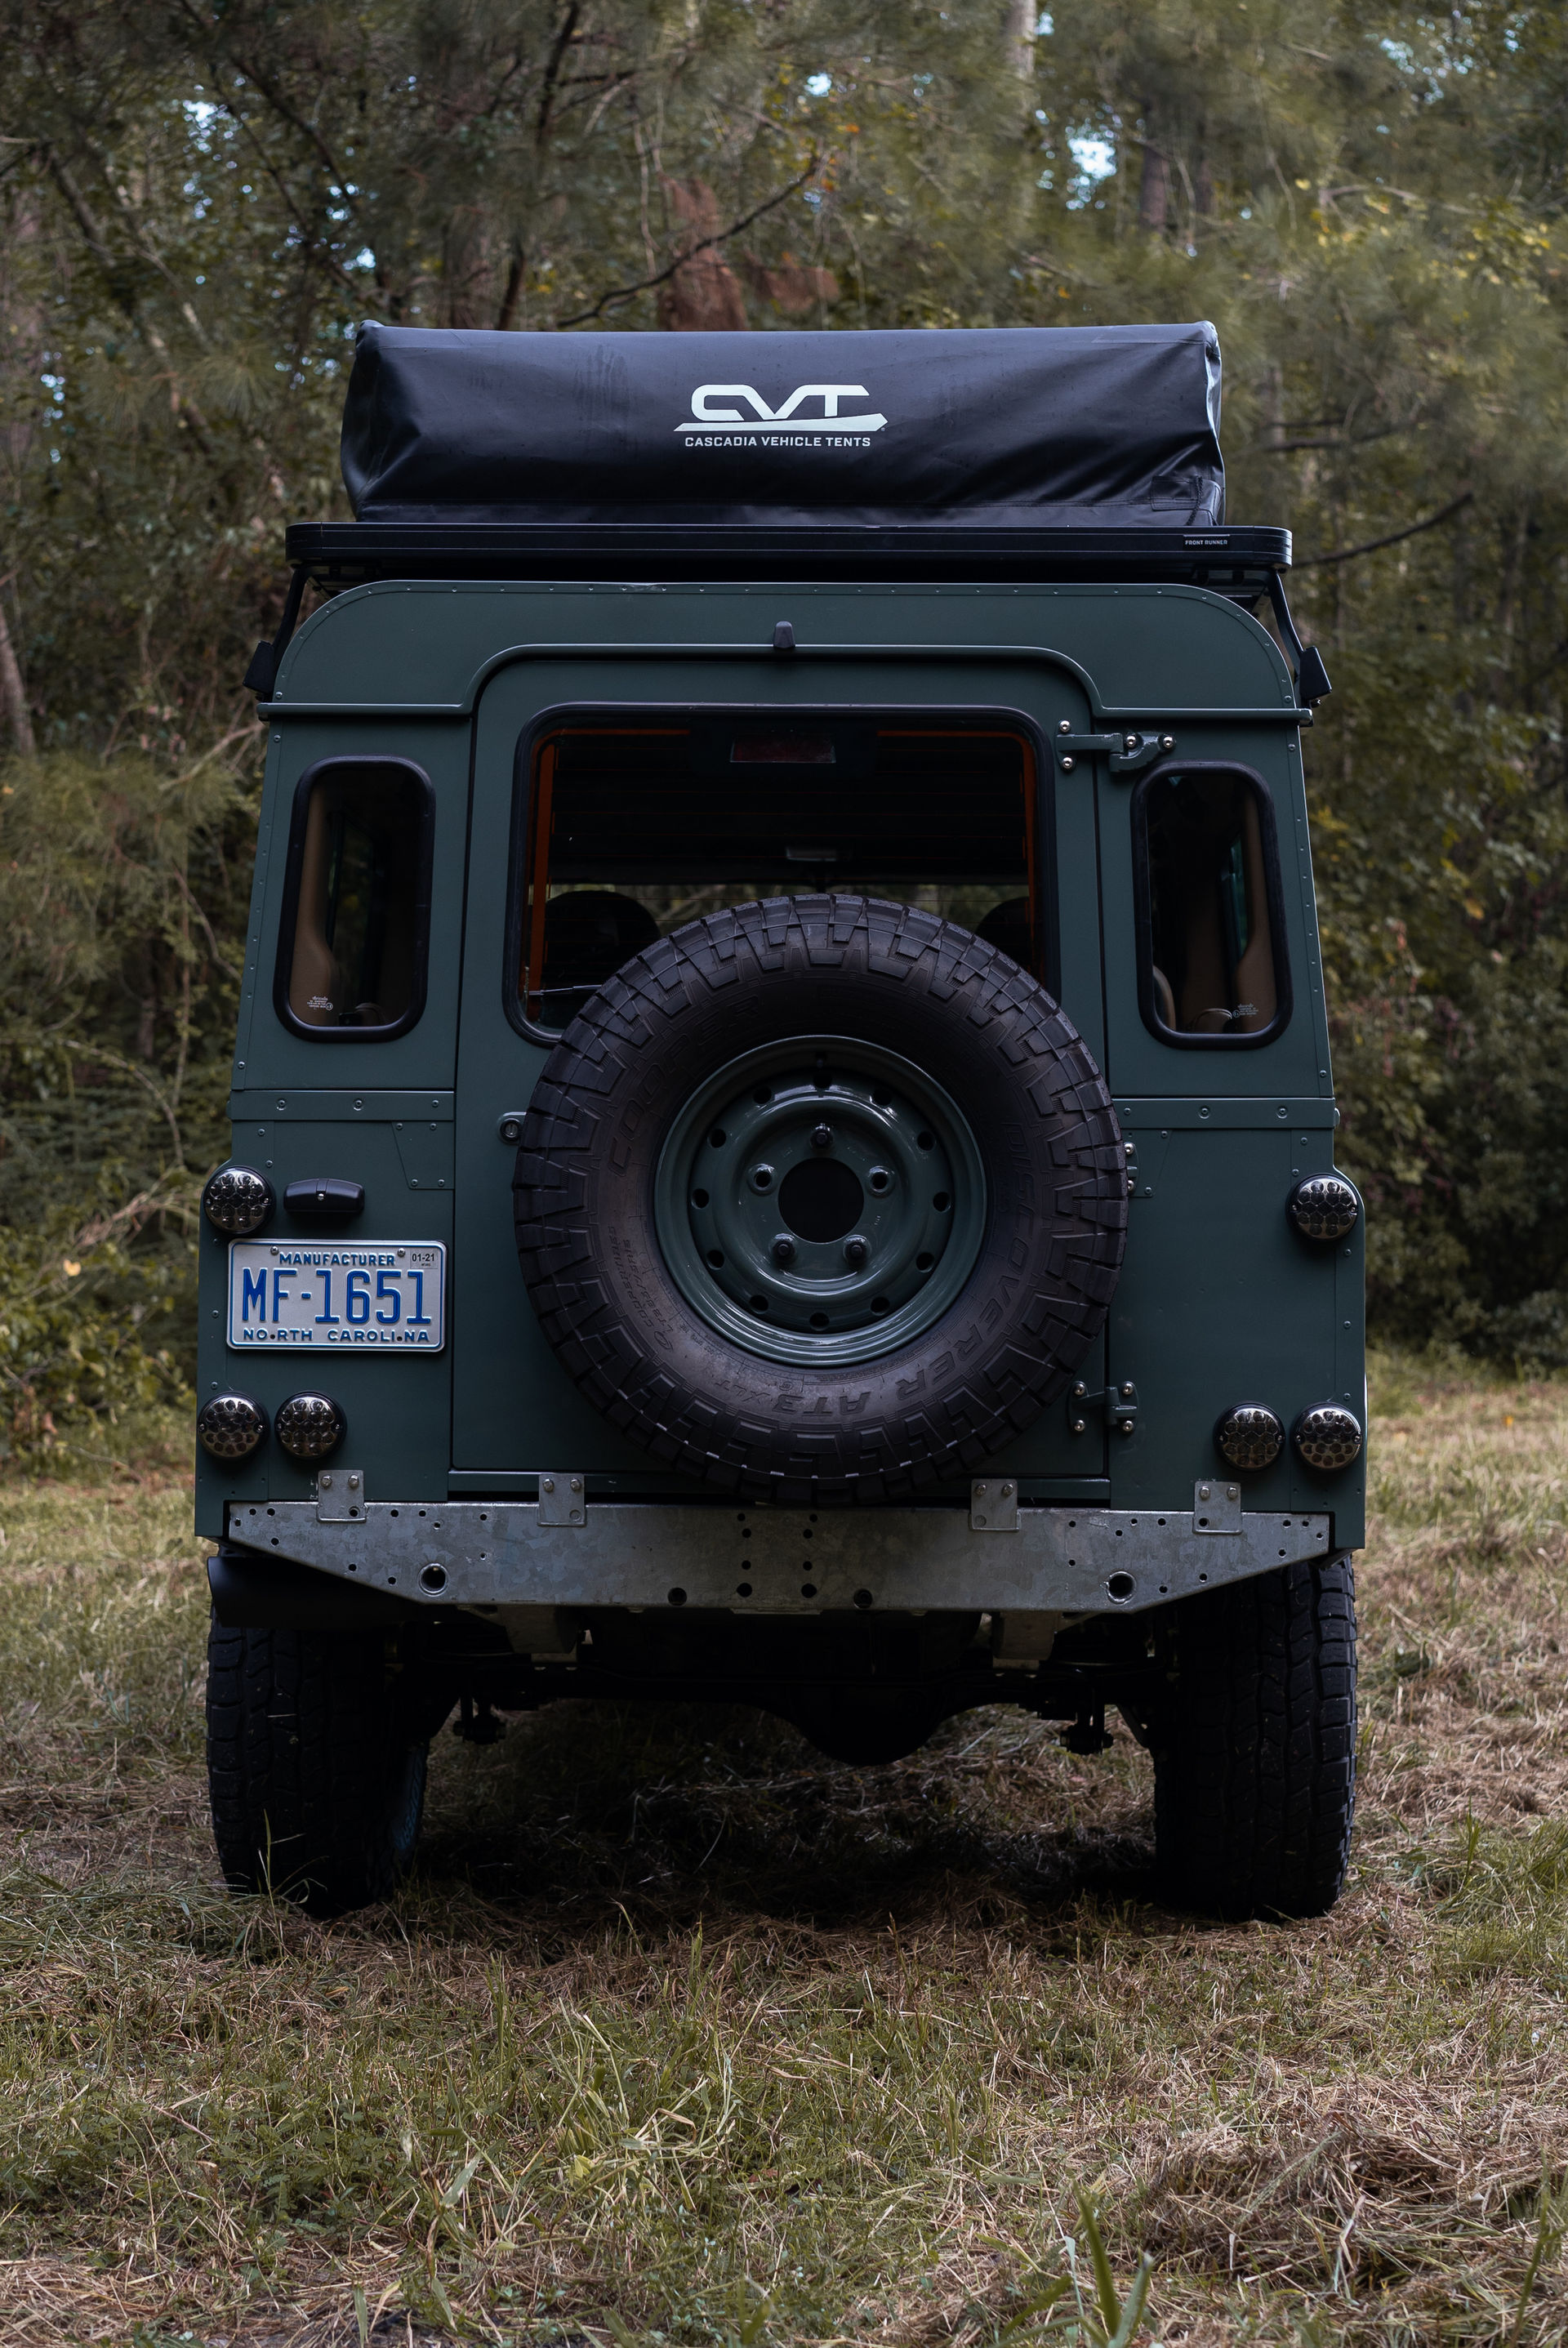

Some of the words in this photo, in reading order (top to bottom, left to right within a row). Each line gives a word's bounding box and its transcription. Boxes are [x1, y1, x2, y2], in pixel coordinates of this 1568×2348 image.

[691, 384, 870, 421] CVT
[685, 437, 757, 447] CASCADIA
[761, 436, 822, 447] VEHICLE
[825, 437, 871, 447] TENTS
[608, 993, 760, 1177] COOPER
[279, 1252, 394, 1266] MANUFACTURER
[412, 1253, 434, 1262] 01-21
[895, 1122, 1036, 1401] DISCOVERER
[243, 1268, 431, 1324] MF-1651
[243, 1327, 313, 1342] NORTH
[327, 1329, 430, 1342] CAROLINA
